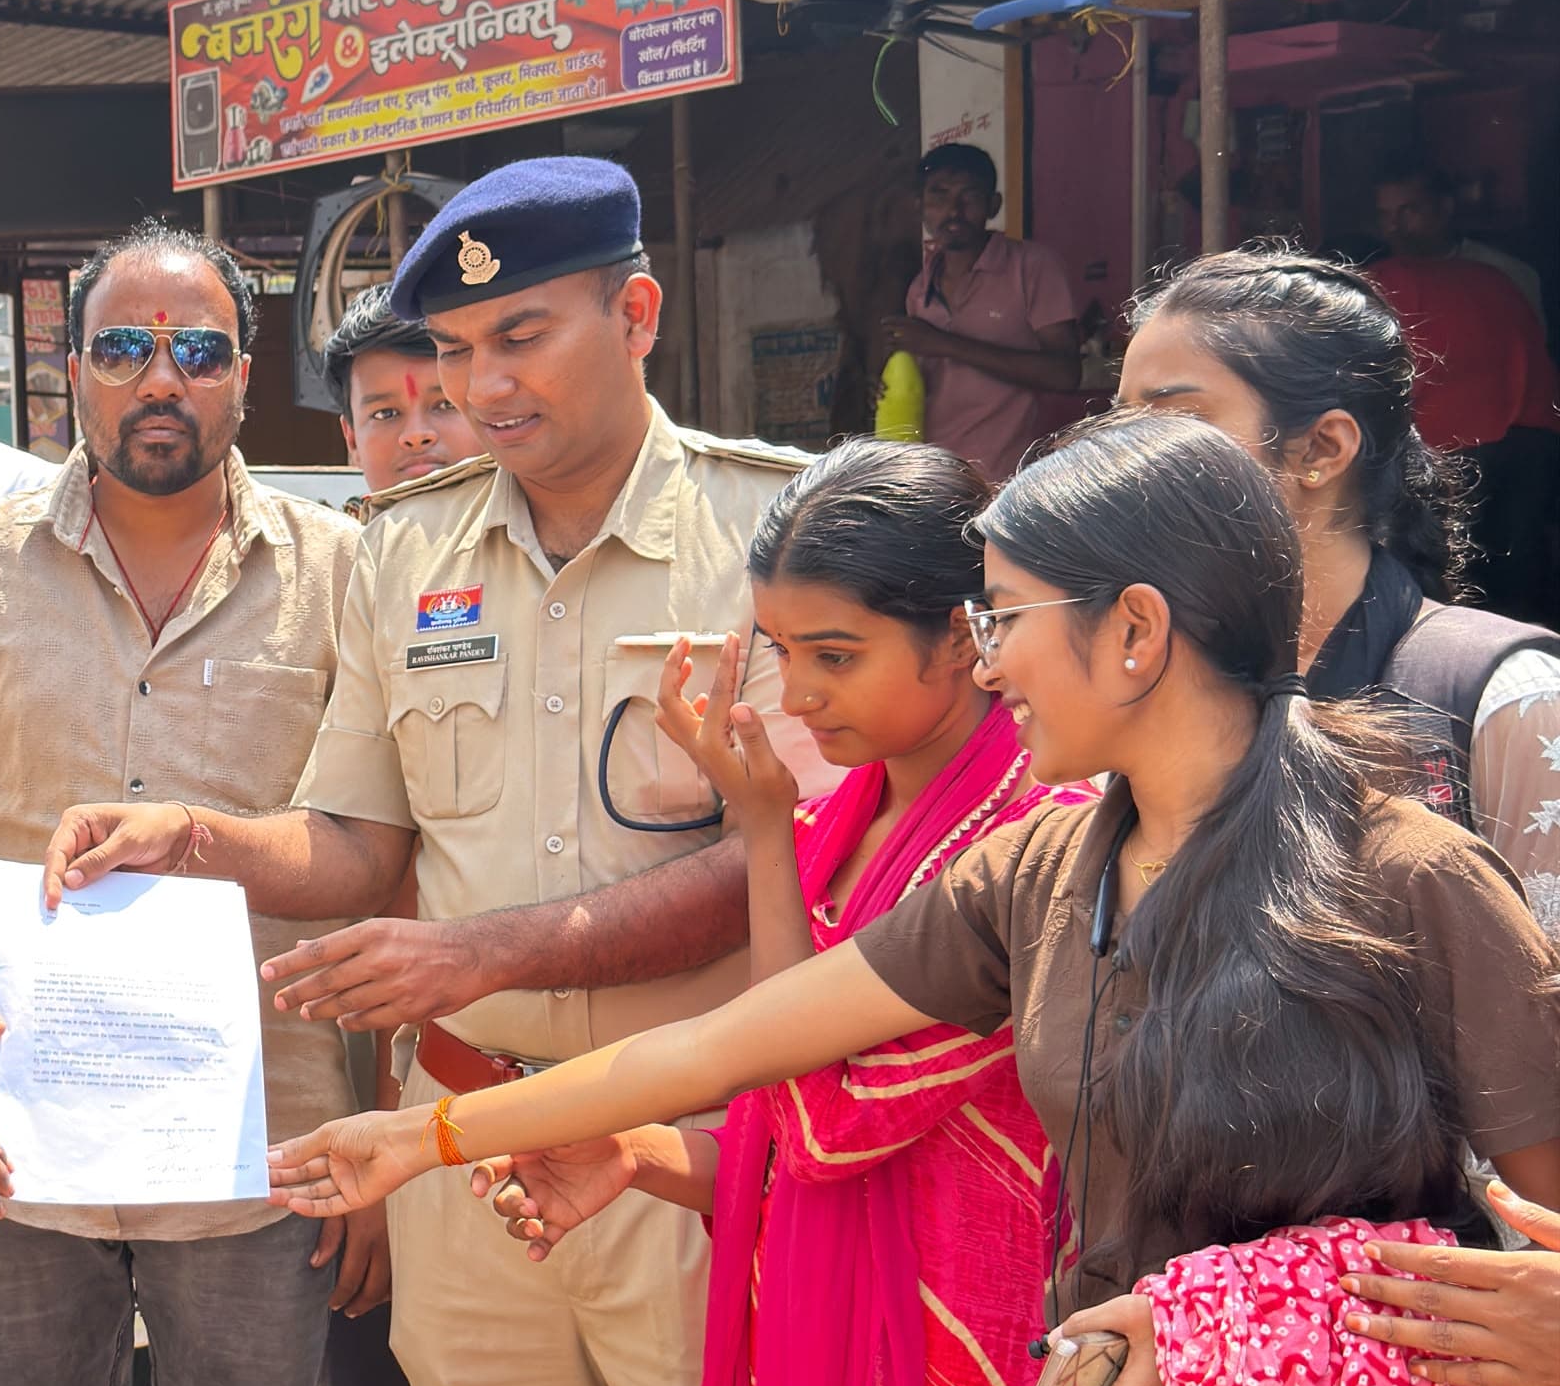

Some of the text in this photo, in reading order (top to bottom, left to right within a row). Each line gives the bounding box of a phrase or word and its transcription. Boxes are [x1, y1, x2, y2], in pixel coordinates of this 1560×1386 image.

[672, 16, 698, 34] मोटर
[699, 11, 716, 27] पंप
[637, 67, 664, 86] किया
[667, 63, 691, 82] जाता
[456, 107, 472, 121] का
[524, 88, 553, 108] किया
[557, 82, 585, 101] जाता
